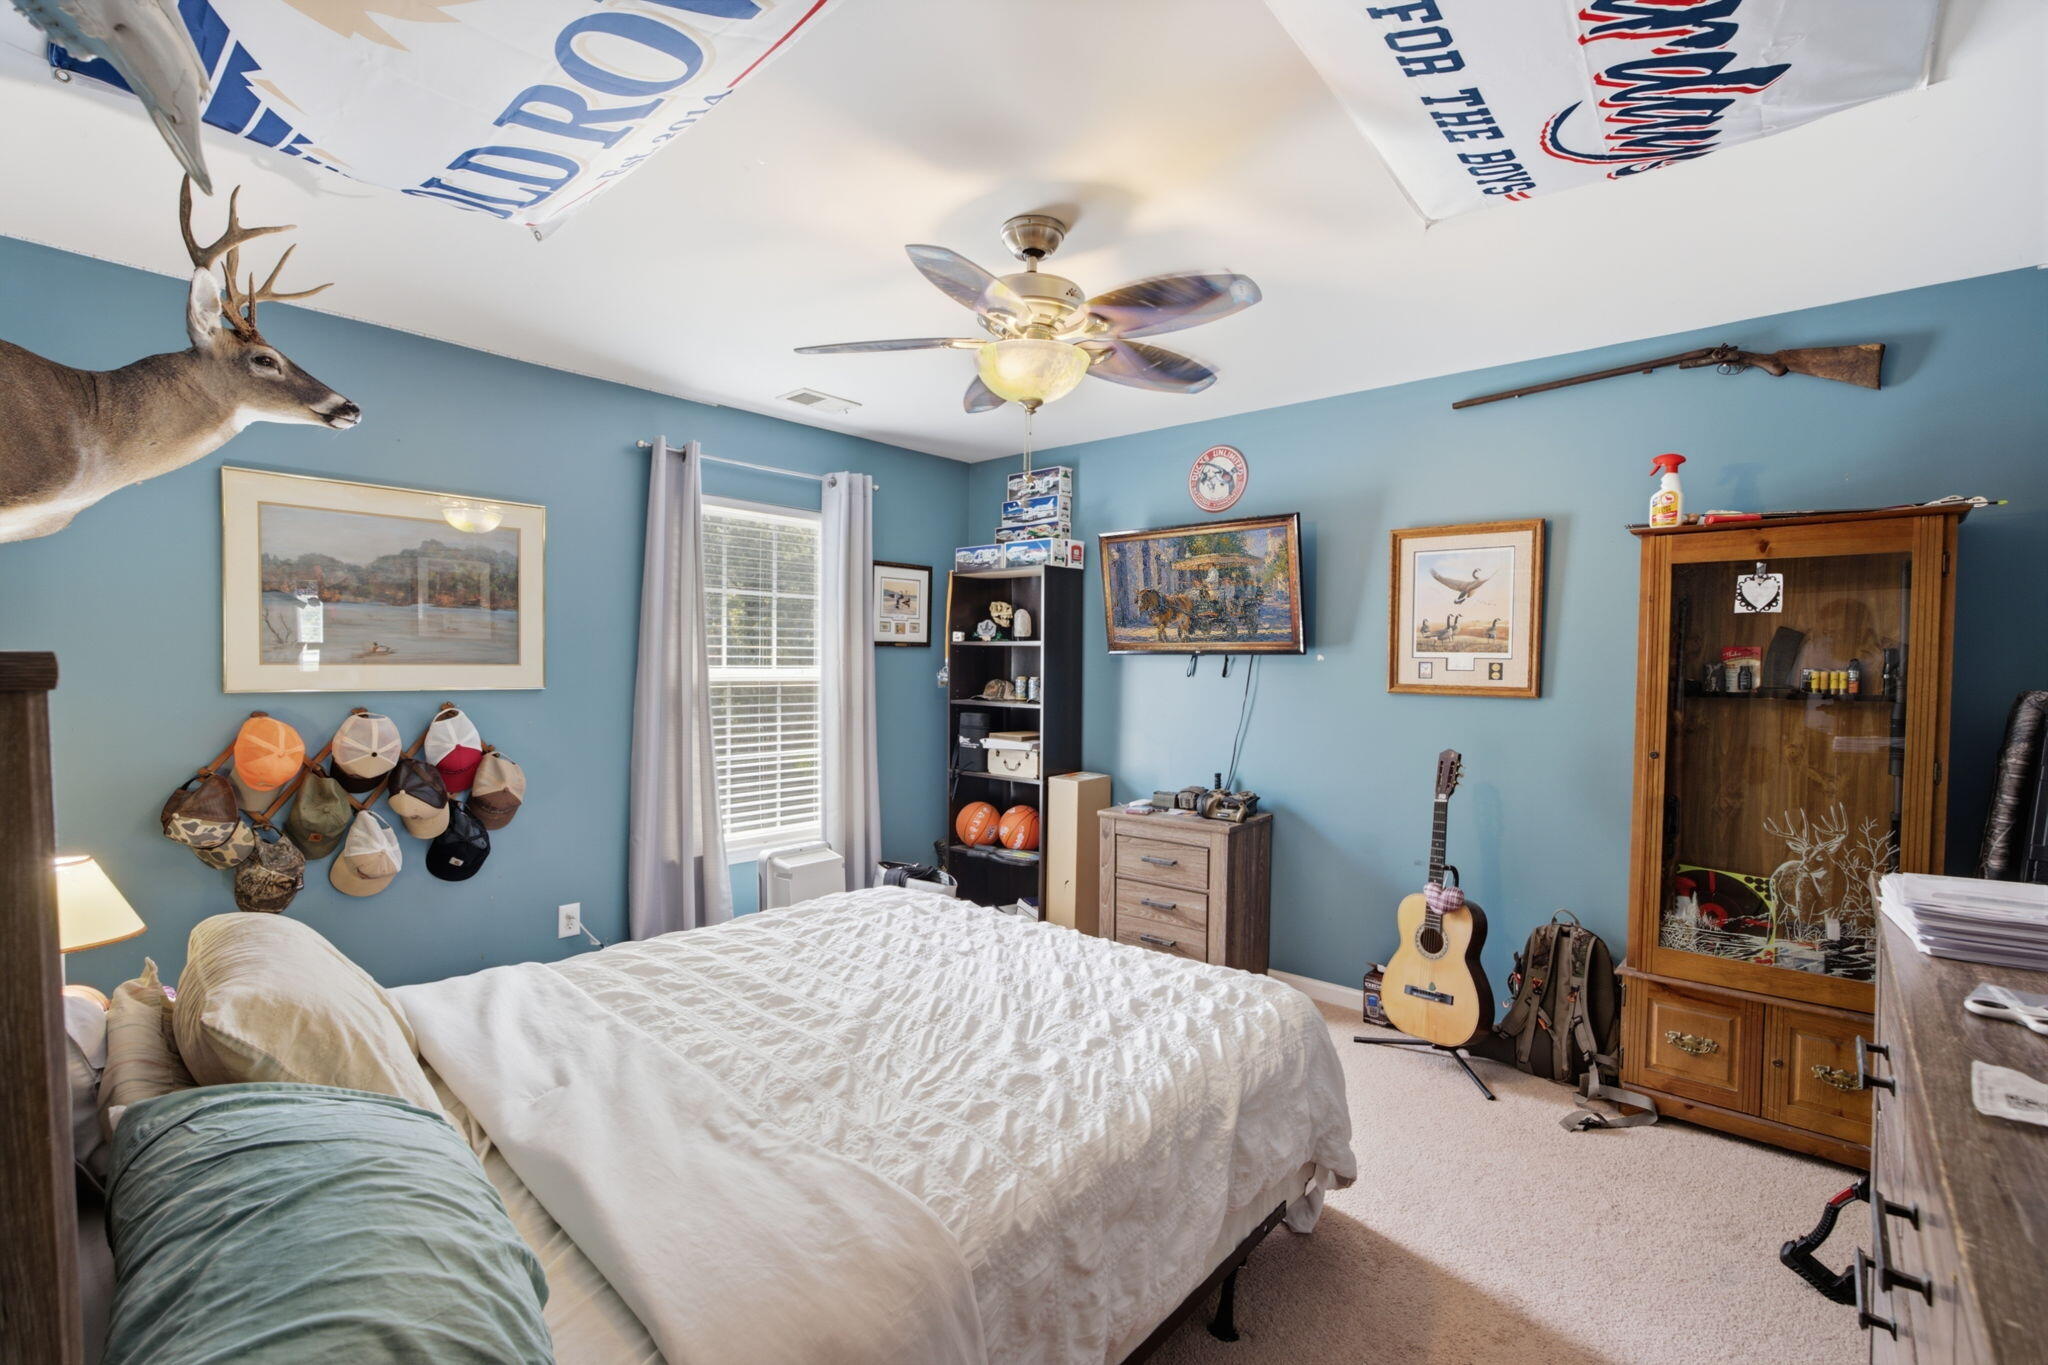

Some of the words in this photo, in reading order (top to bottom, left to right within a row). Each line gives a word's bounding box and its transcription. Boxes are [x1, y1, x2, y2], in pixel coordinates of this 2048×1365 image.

[1366, 0, 1465, 77] FOR
[1420, 87, 1504, 142] THE
[1457, 149, 1536, 195] BOYS
